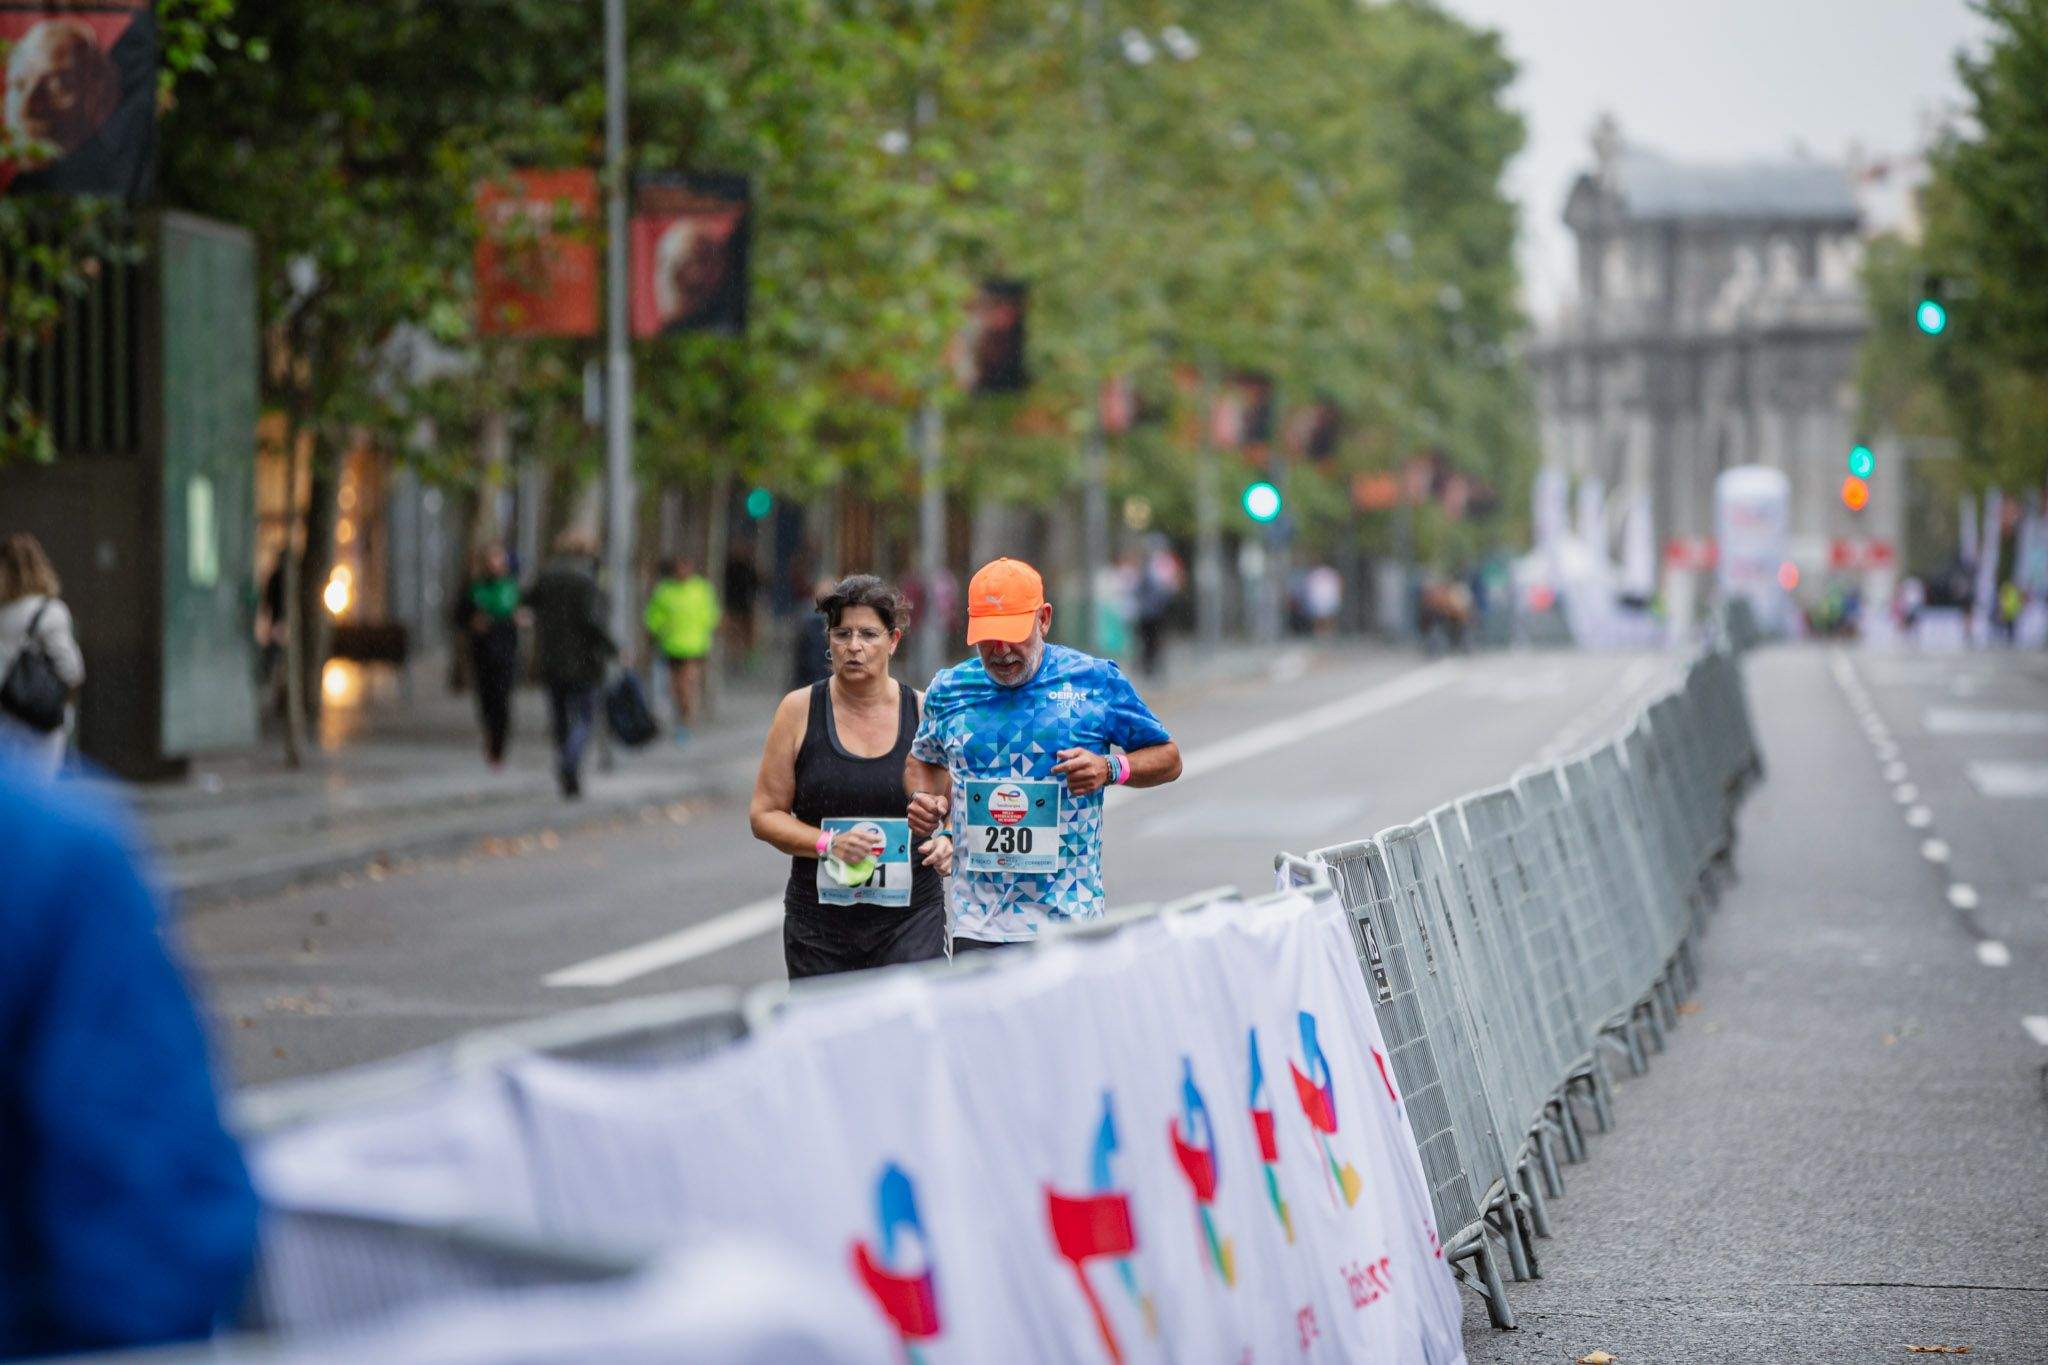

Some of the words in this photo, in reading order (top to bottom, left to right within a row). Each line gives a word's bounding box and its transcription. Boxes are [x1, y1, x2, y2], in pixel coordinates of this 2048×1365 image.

[1048, 691, 1087, 701] OEIRAS
[1056, 700, 1079, 708] RUN
[985, 826, 1033, 854] 230
